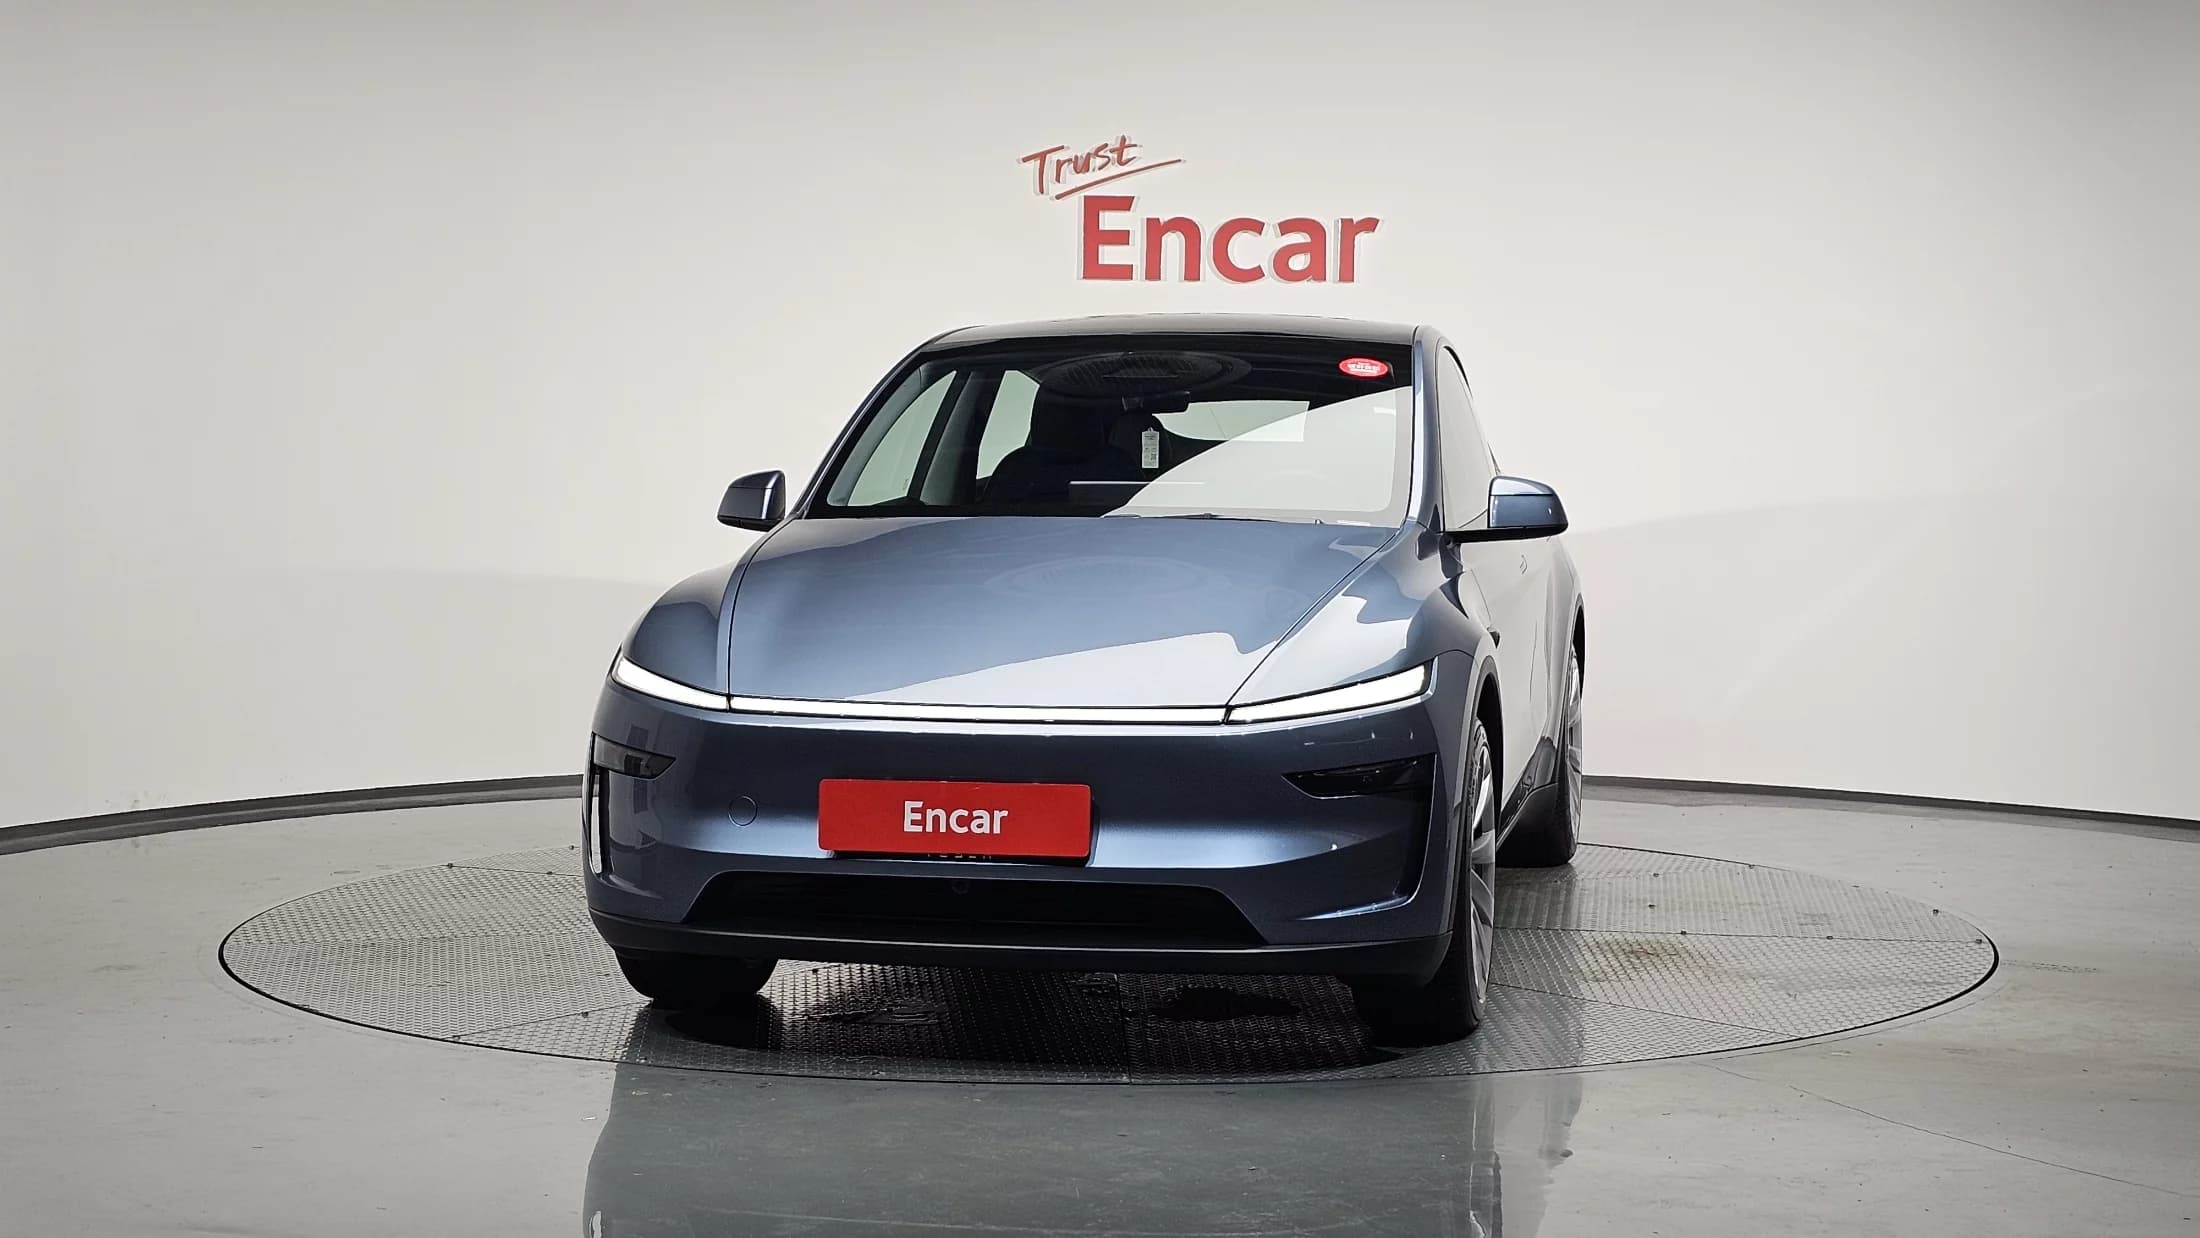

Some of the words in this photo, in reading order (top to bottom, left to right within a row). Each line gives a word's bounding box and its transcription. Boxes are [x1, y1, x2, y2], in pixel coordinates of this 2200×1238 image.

[1020, 134, 1140, 195] Trust
[1082, 195, 1380, 283] Encar
[903, 800, 1008, 834] Encar
